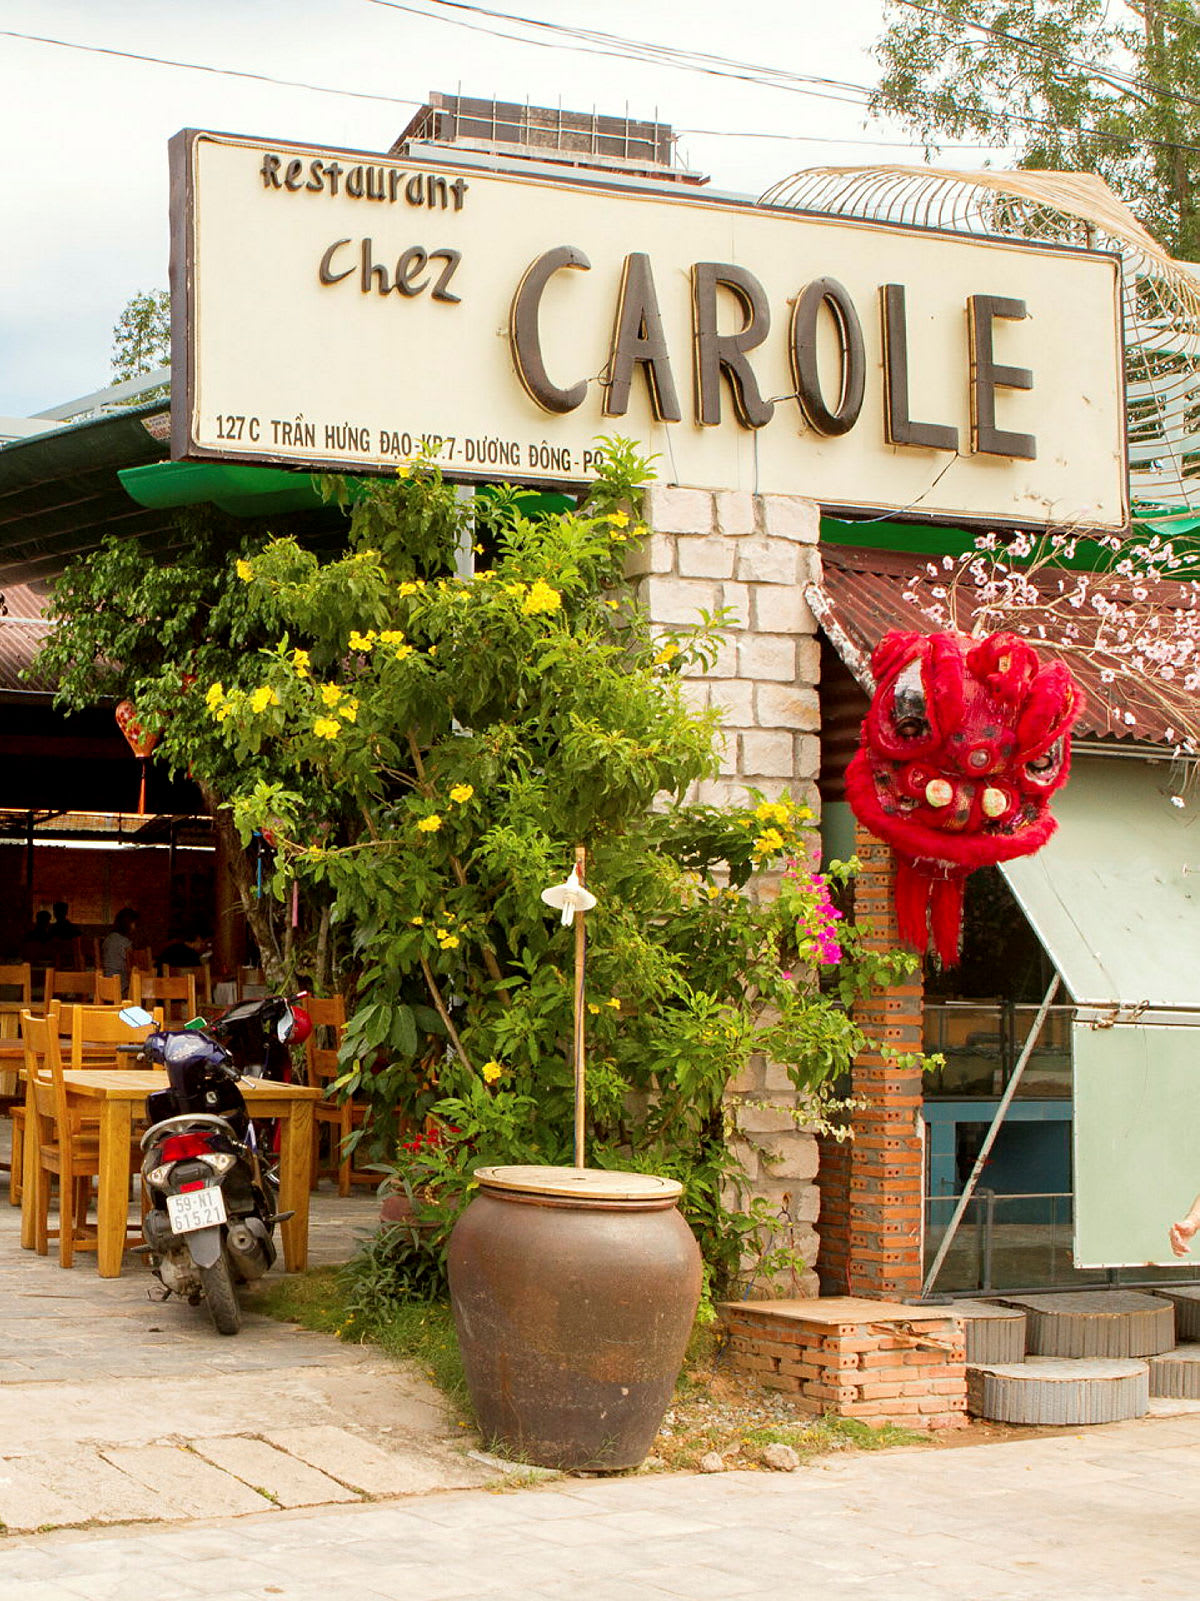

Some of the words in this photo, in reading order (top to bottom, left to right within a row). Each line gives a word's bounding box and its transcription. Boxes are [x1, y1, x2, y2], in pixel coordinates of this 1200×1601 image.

[259, 153, 469, 211] Restaurant
[509, 245, 1037, 461] CAROLE
[270, 412, 316, 447] TRẦN
[324, 421, 370, 453] HƯNG
